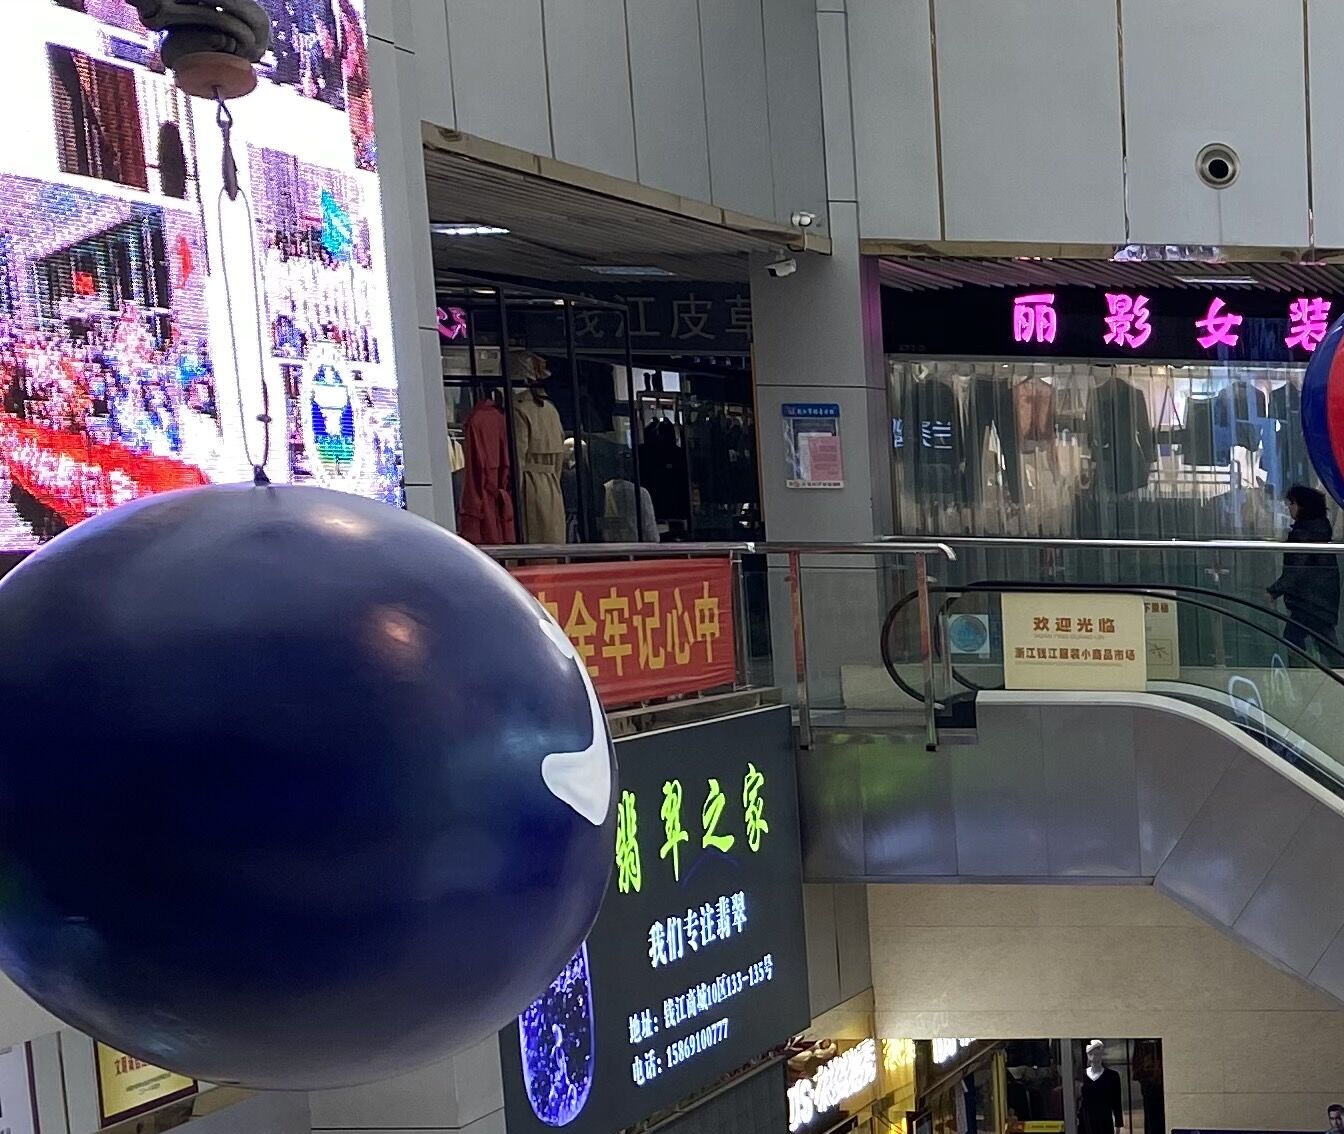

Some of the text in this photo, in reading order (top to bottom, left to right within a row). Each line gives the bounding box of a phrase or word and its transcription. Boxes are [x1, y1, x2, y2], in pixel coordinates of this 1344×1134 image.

[1013, 293, 1331, 351] 丽影女装
[1033, 617, 1115, 633] 欢迎光临
[616, 763, 769, 894] 翡翠之家
[649, 891, 748, 968] 我们专注翡翠
